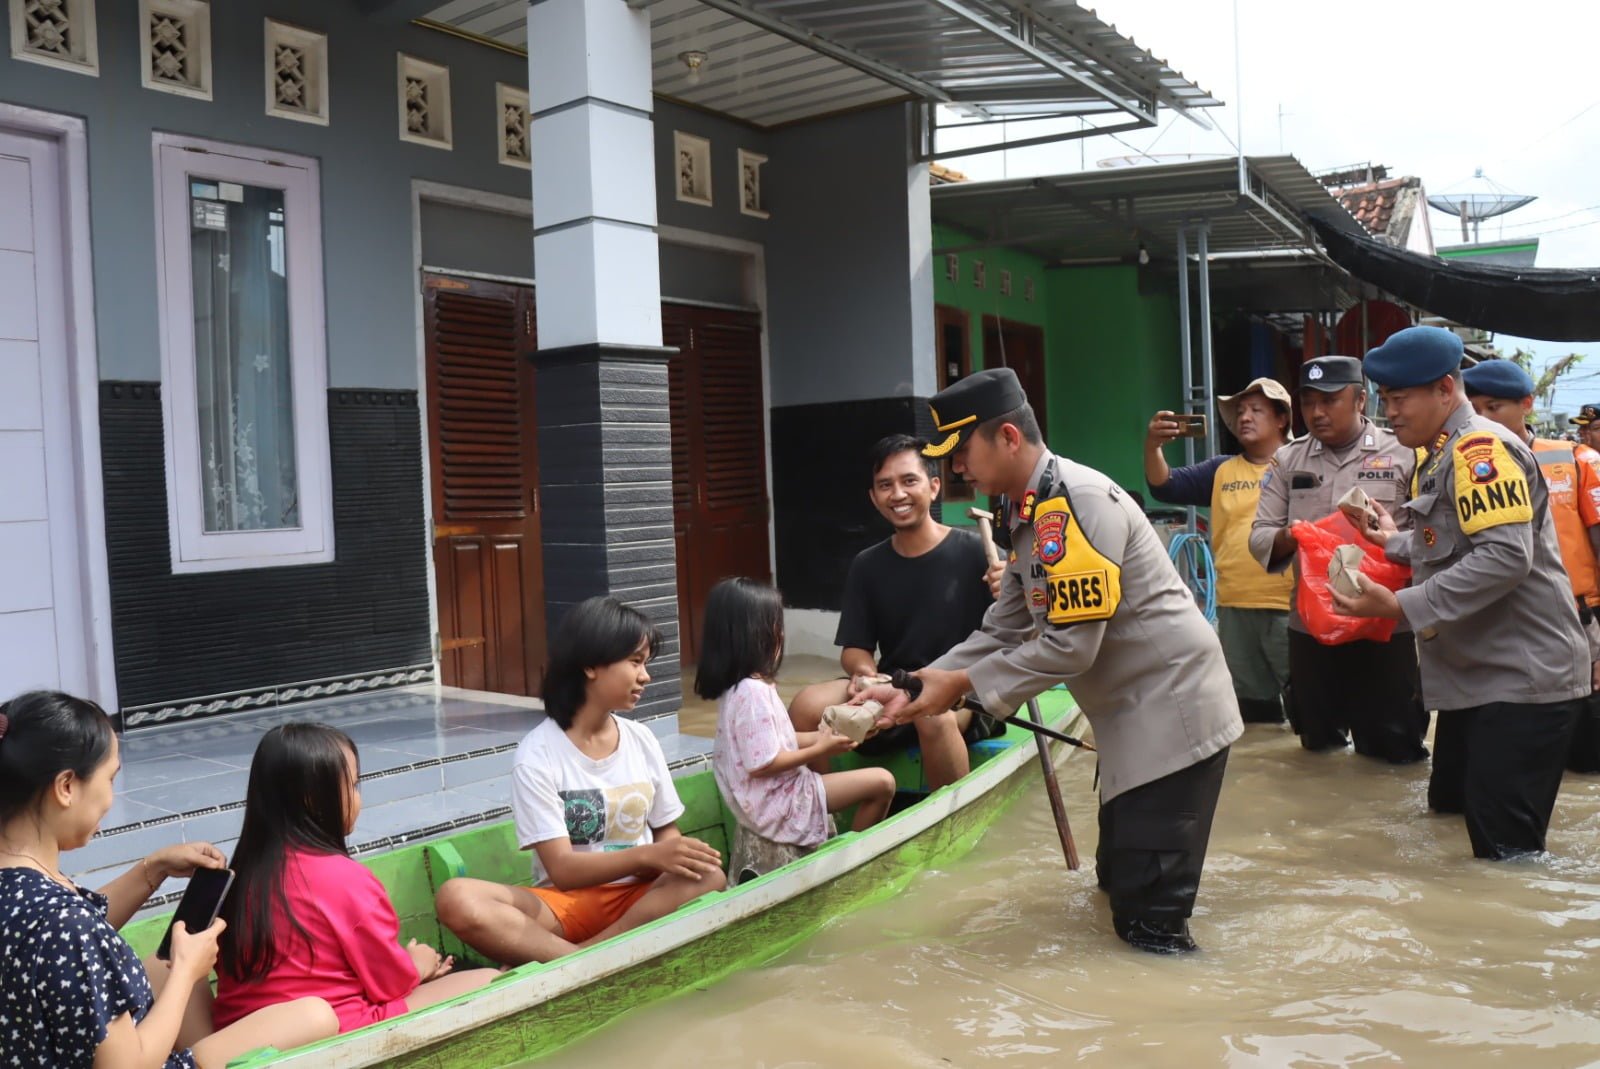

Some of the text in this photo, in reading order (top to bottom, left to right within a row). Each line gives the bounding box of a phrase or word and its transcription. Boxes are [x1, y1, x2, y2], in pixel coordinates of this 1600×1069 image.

[1358, 471, 1394, 479] POLRI
[1221, 480, 1261, 492] #STAY
[1458, 480, 1528, 522] DANKI
